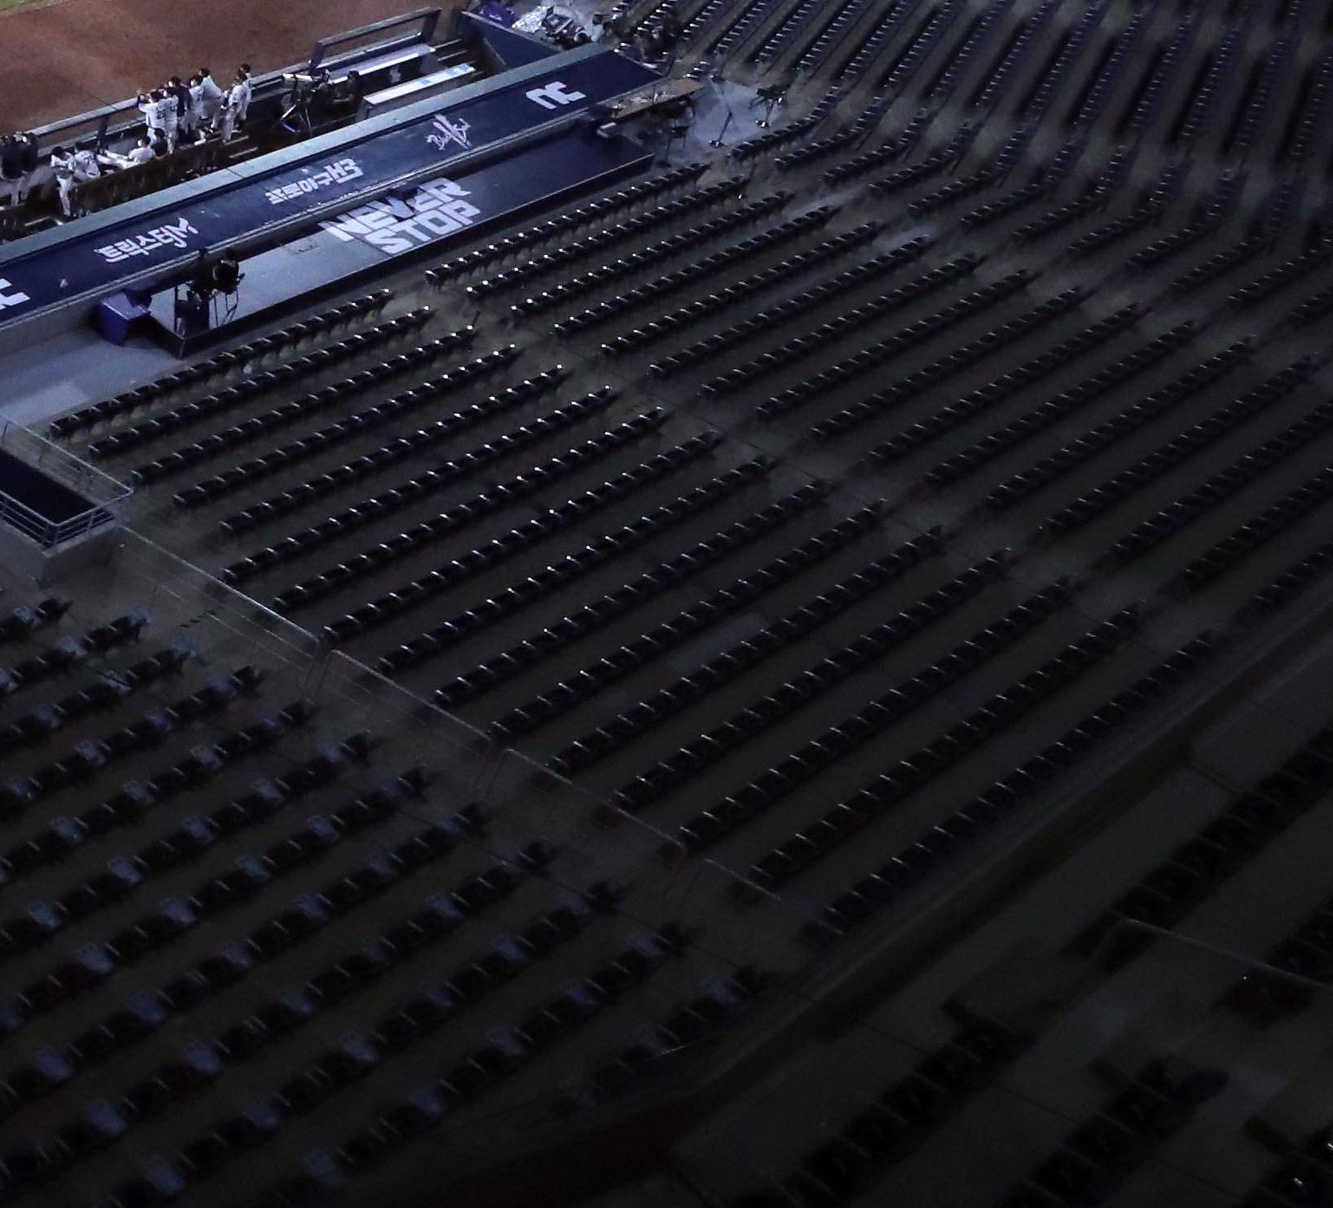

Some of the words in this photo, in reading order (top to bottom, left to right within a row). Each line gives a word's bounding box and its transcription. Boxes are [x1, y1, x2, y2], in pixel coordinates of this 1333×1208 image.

[526, 81, 587, 110] NC
[317, 177, 472, 243] NEVER
[364, 199, 481, 255] STOP
[94, 218, 199, 263] 트릭스터M
